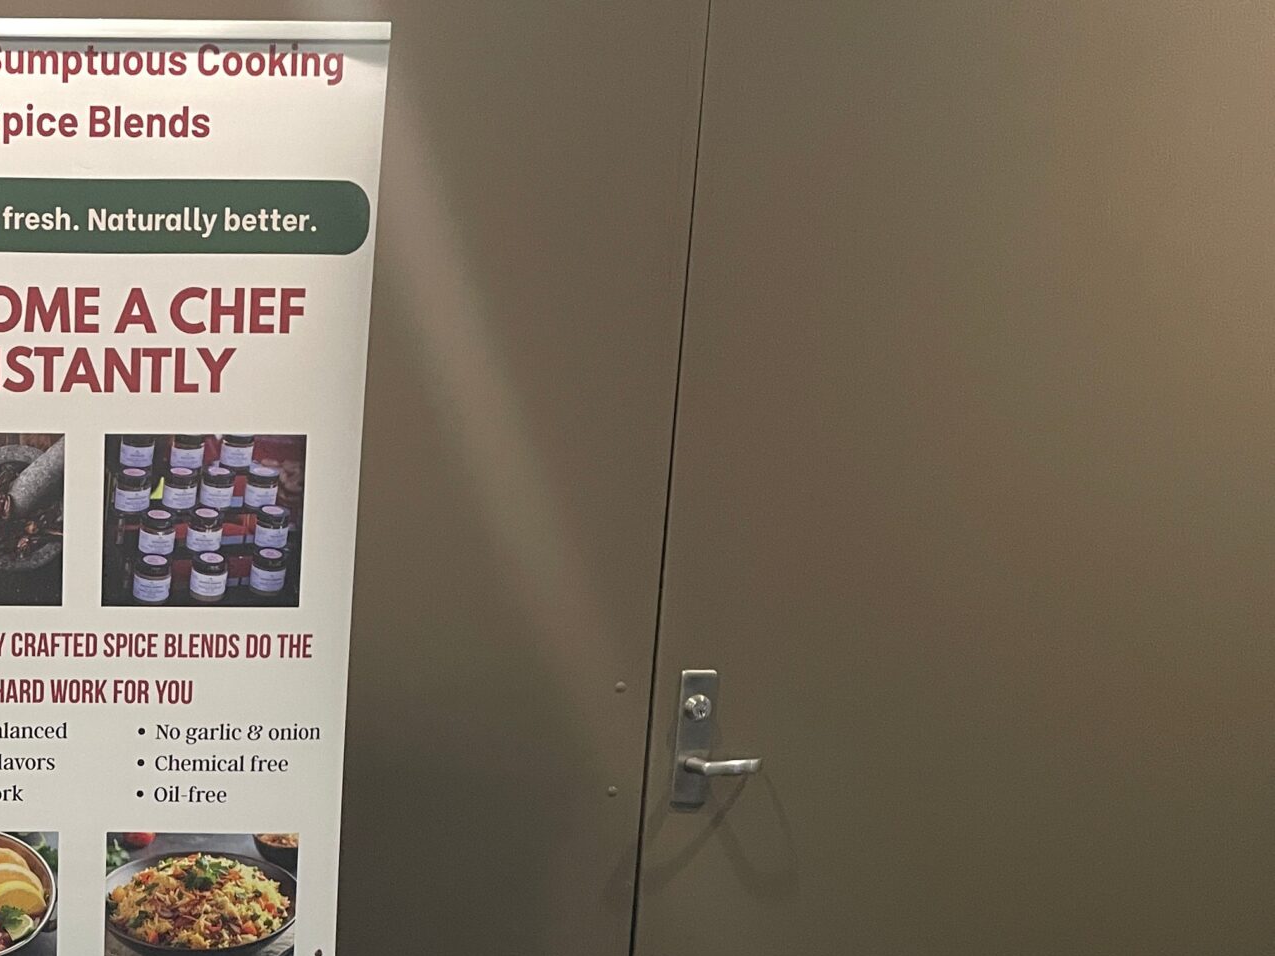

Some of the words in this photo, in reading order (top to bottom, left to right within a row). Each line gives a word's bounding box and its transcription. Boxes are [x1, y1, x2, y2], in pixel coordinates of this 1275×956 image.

[198, 44, 344, 85] Cooking
[89, 106, 210, 138] Blends
[3, 206, 79, 230] fresh.
[89, 207, 217, 238] Naturally
[225, 207, 316, 231] better.
[114, 288, 157, 333] A
[170, 287, 306, 334] CHEF
[12, 633, 97, 657] CRAFTED
[104, 633, 158, 657] SPICE
[165, 634, 239, 658] BLENDS
[246, 634, 271, 658] DO
[277, 634, 313, 658] THE
[51, 679, 107, 703] WORK
[114, 680, 149, 703] FOR
[155, 680, 192, 704] YOU
[156, 725, 180, 740] No
[186, 724, 241, 744] garlic
[247, 725, 263, 740] &
[269, 724, 320, 740] onion
[155, 755, 244, 771] Chemical
[251, 755, 288, 772] free
[154, 786, 226, 803] Oil-free
